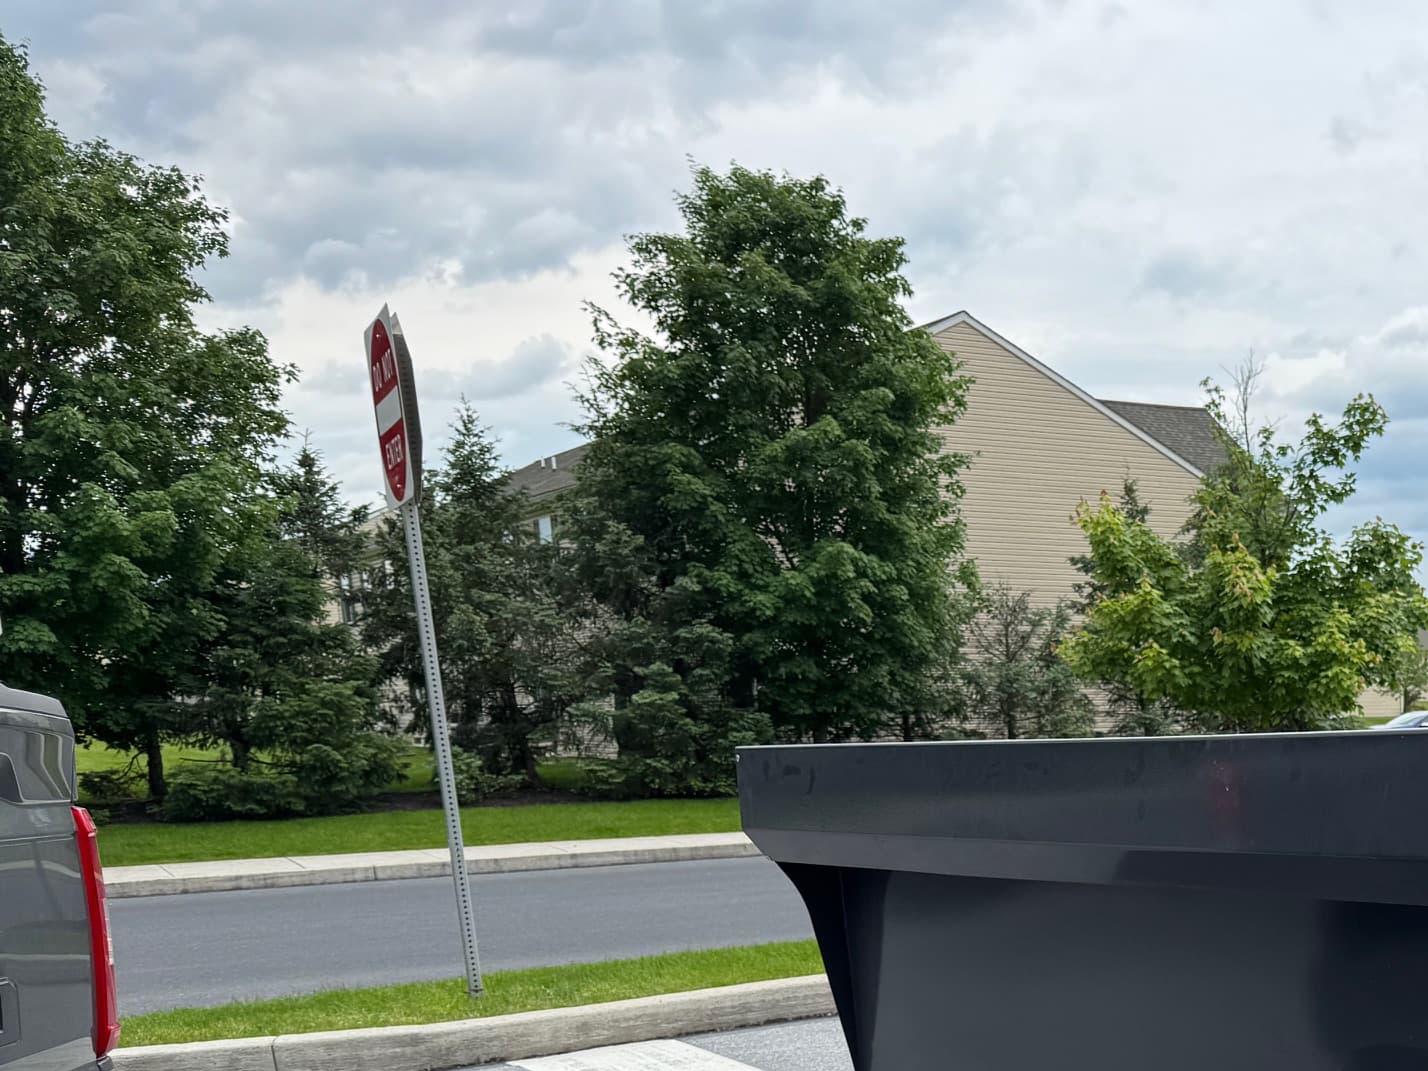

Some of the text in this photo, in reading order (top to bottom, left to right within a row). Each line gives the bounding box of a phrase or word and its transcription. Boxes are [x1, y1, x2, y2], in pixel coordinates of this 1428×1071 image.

[373, 349, 394, 392] DO NOT
[385, 433, 405, 471] ENTER
